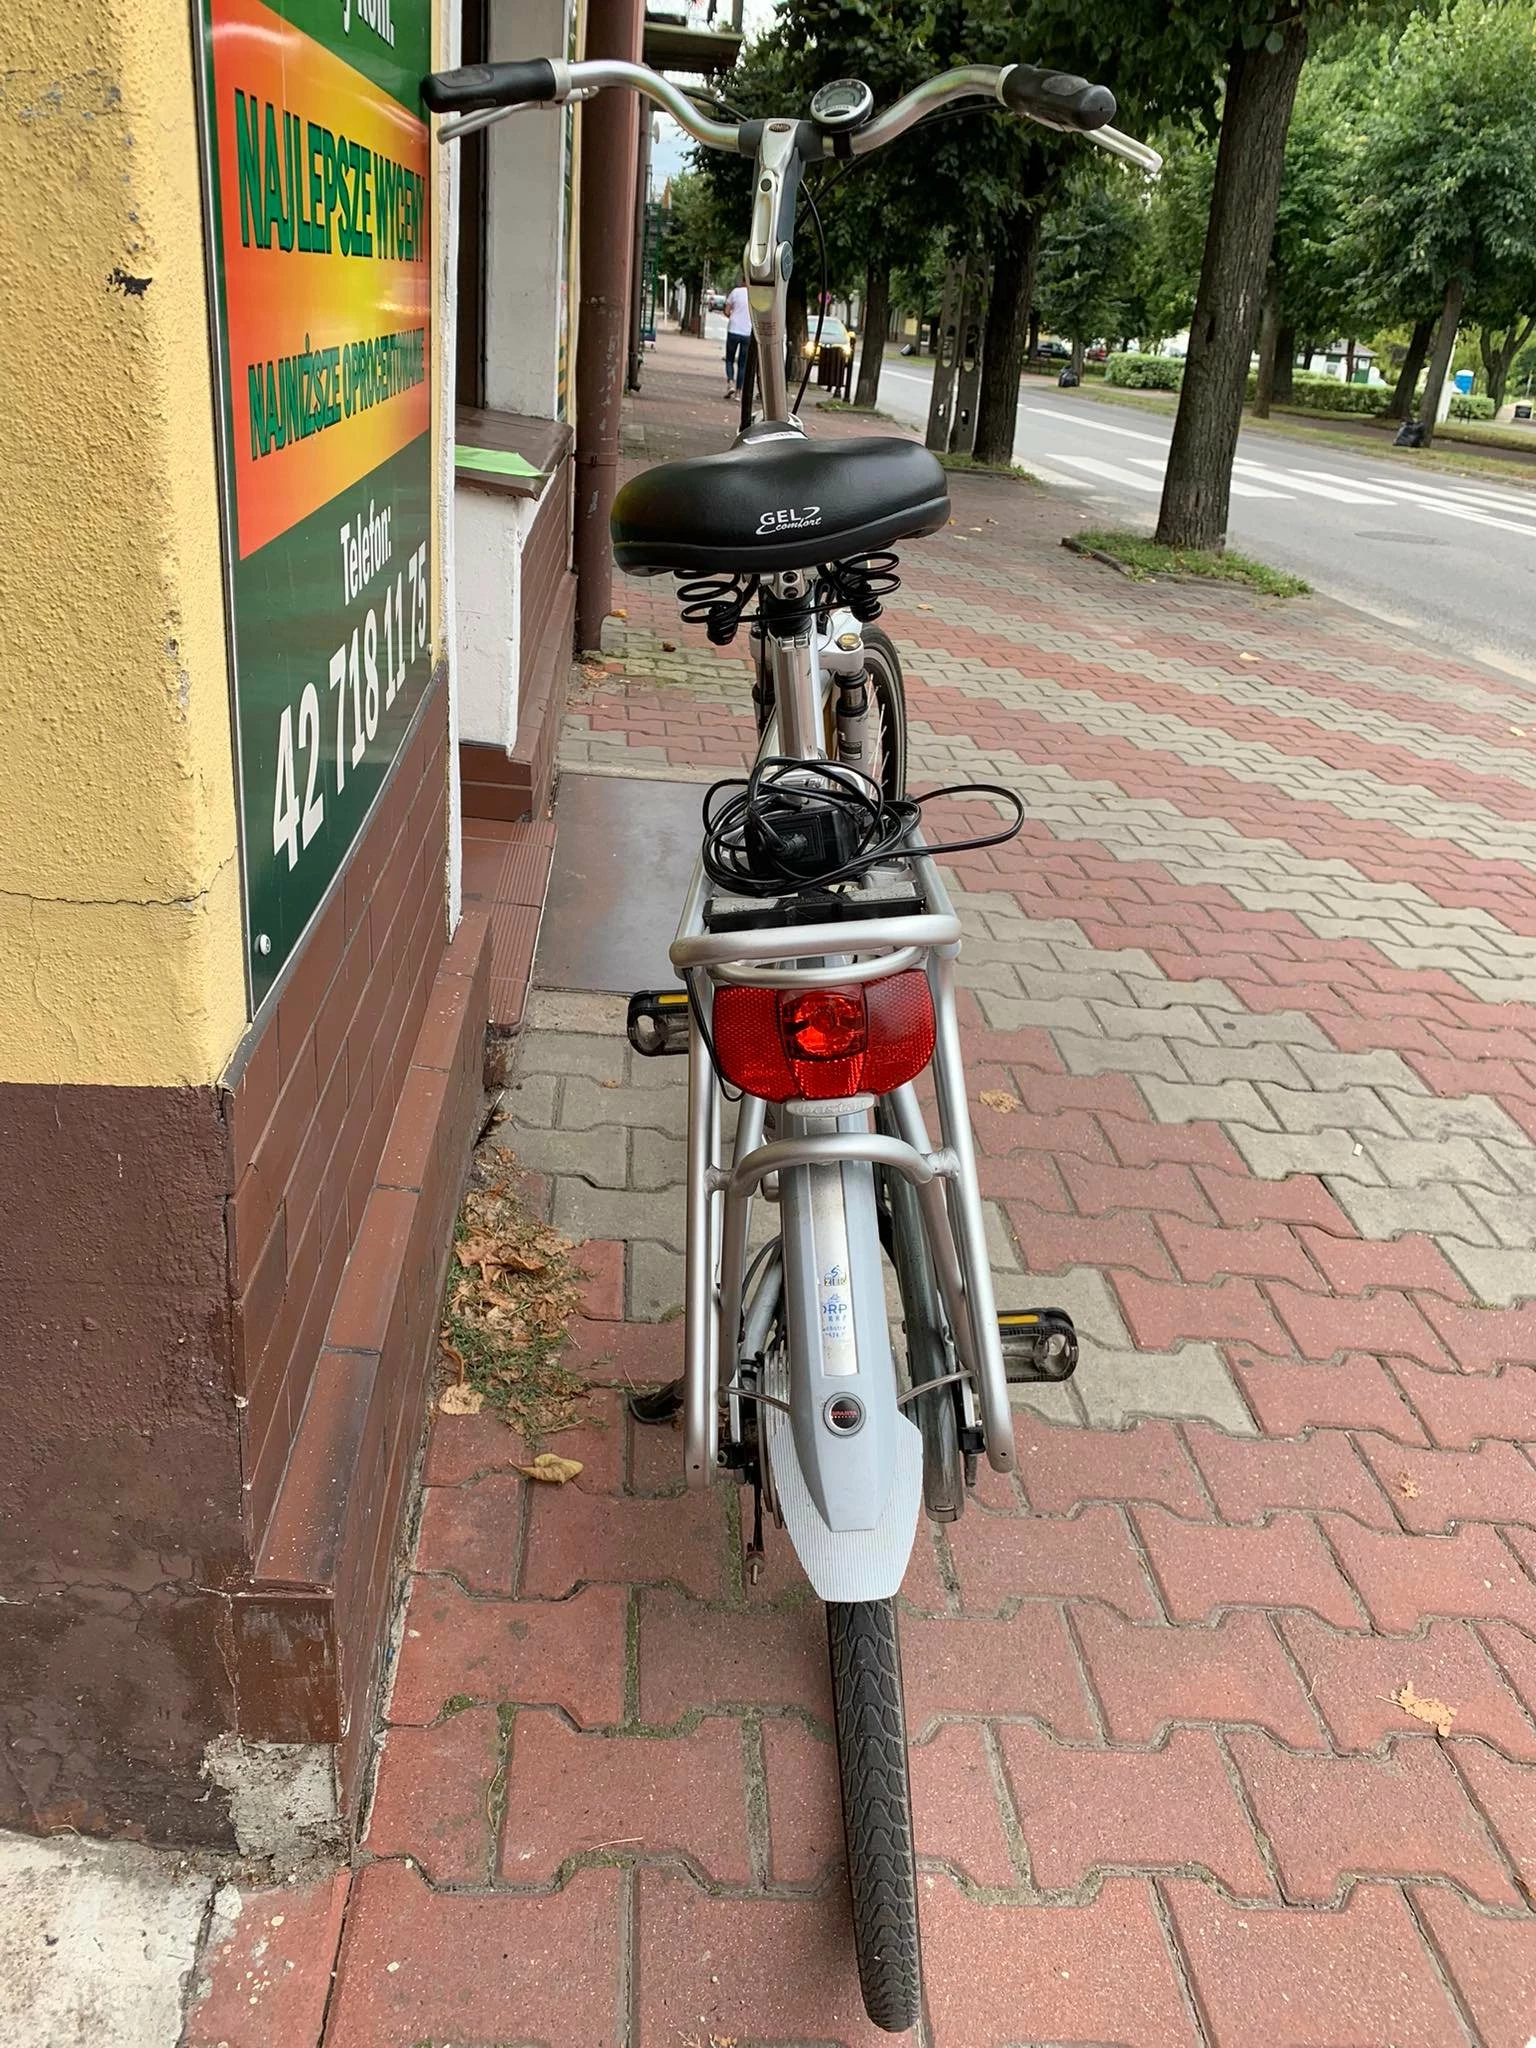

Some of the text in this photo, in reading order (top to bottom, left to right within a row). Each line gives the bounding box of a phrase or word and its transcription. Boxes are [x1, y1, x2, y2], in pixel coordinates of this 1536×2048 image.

[235, 88, 425, 262] NAJLEPSZE WYCENY
[247, 333, 341, 462] NAJNIŻSZE
[340, 498, 391, 606] Telefon:
[760, 508, 801, 525] GEL
[775, 516, 822, 531] comfort
[273, 541, 427, 872] 42 718 11 75
